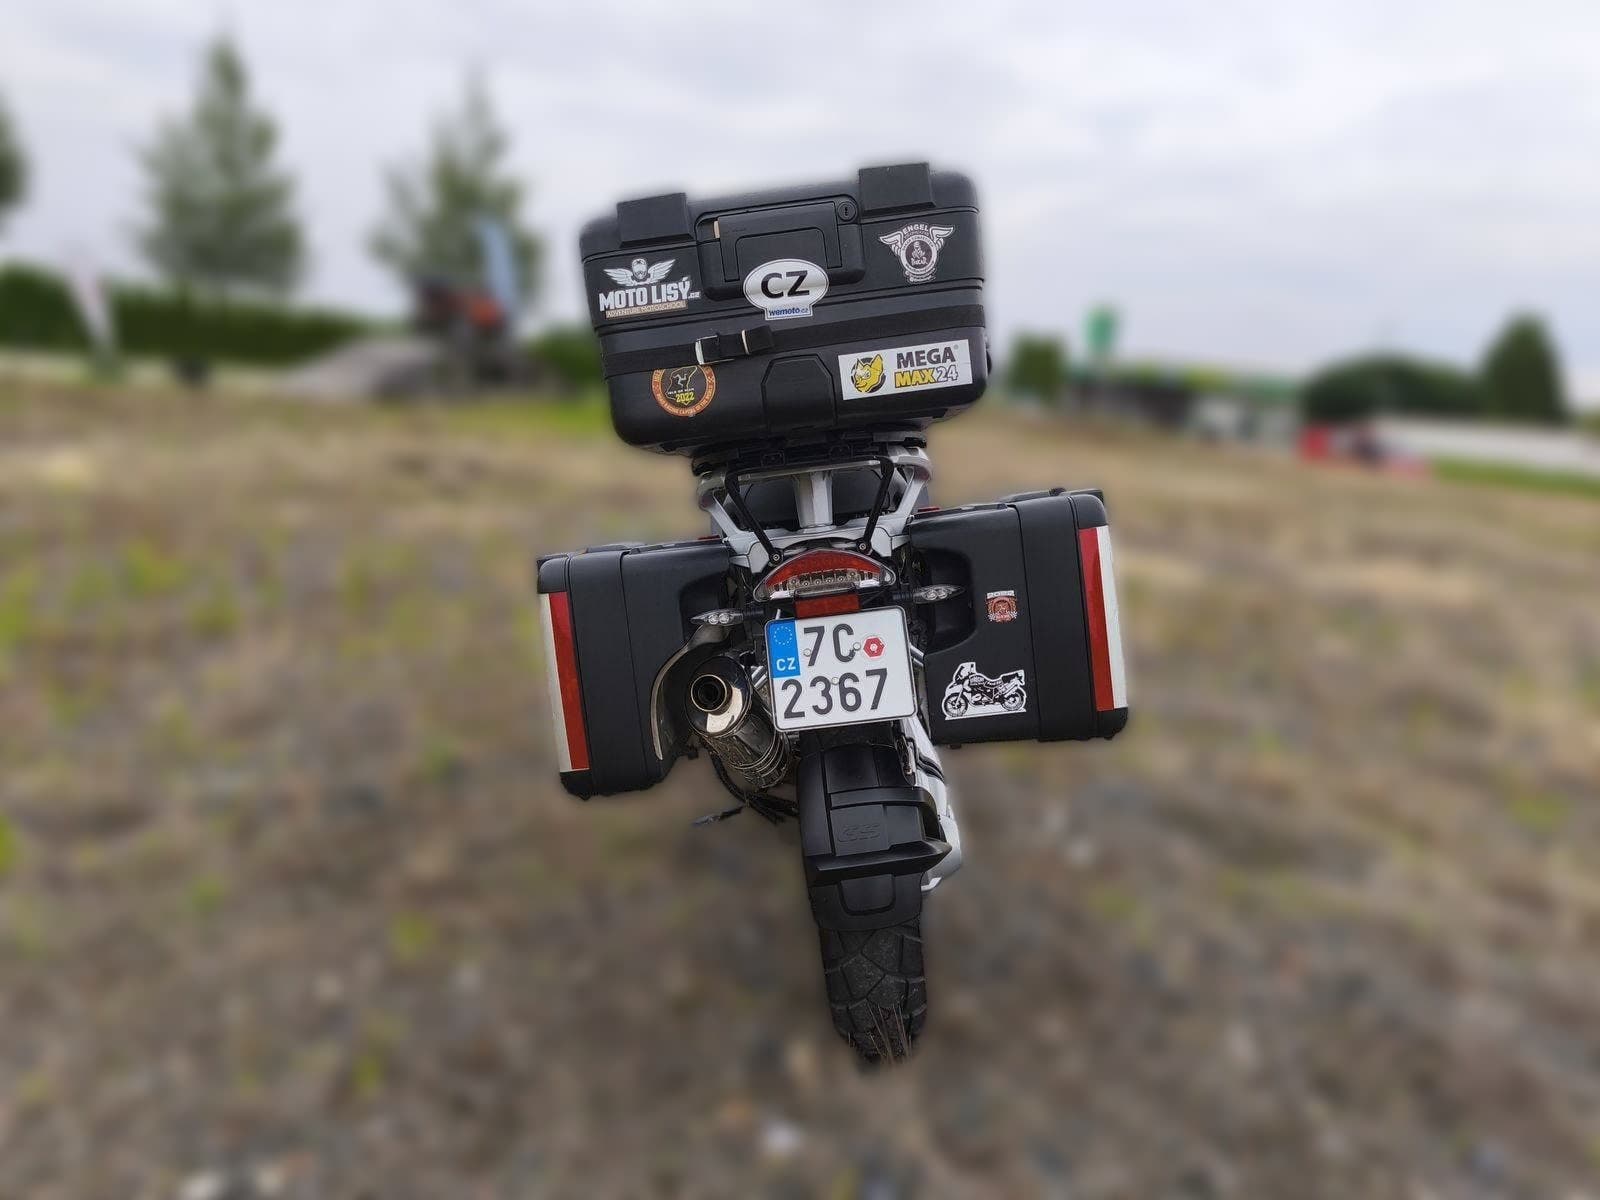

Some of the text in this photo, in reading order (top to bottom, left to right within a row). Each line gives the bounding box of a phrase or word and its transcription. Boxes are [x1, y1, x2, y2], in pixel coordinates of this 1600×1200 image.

[903, 223, 929, 235] ENGEL
[761, 270, 810, 299] CZ
[599, 287, 648, 311] MOTO
[897, 346, 956, 369] MEGA
[676, 392, 695, 403] 2022
[803, 623, 856, 667] 7C
[776, 657, 797, 671] CZ
[781, 667, 888, 719] 2367
